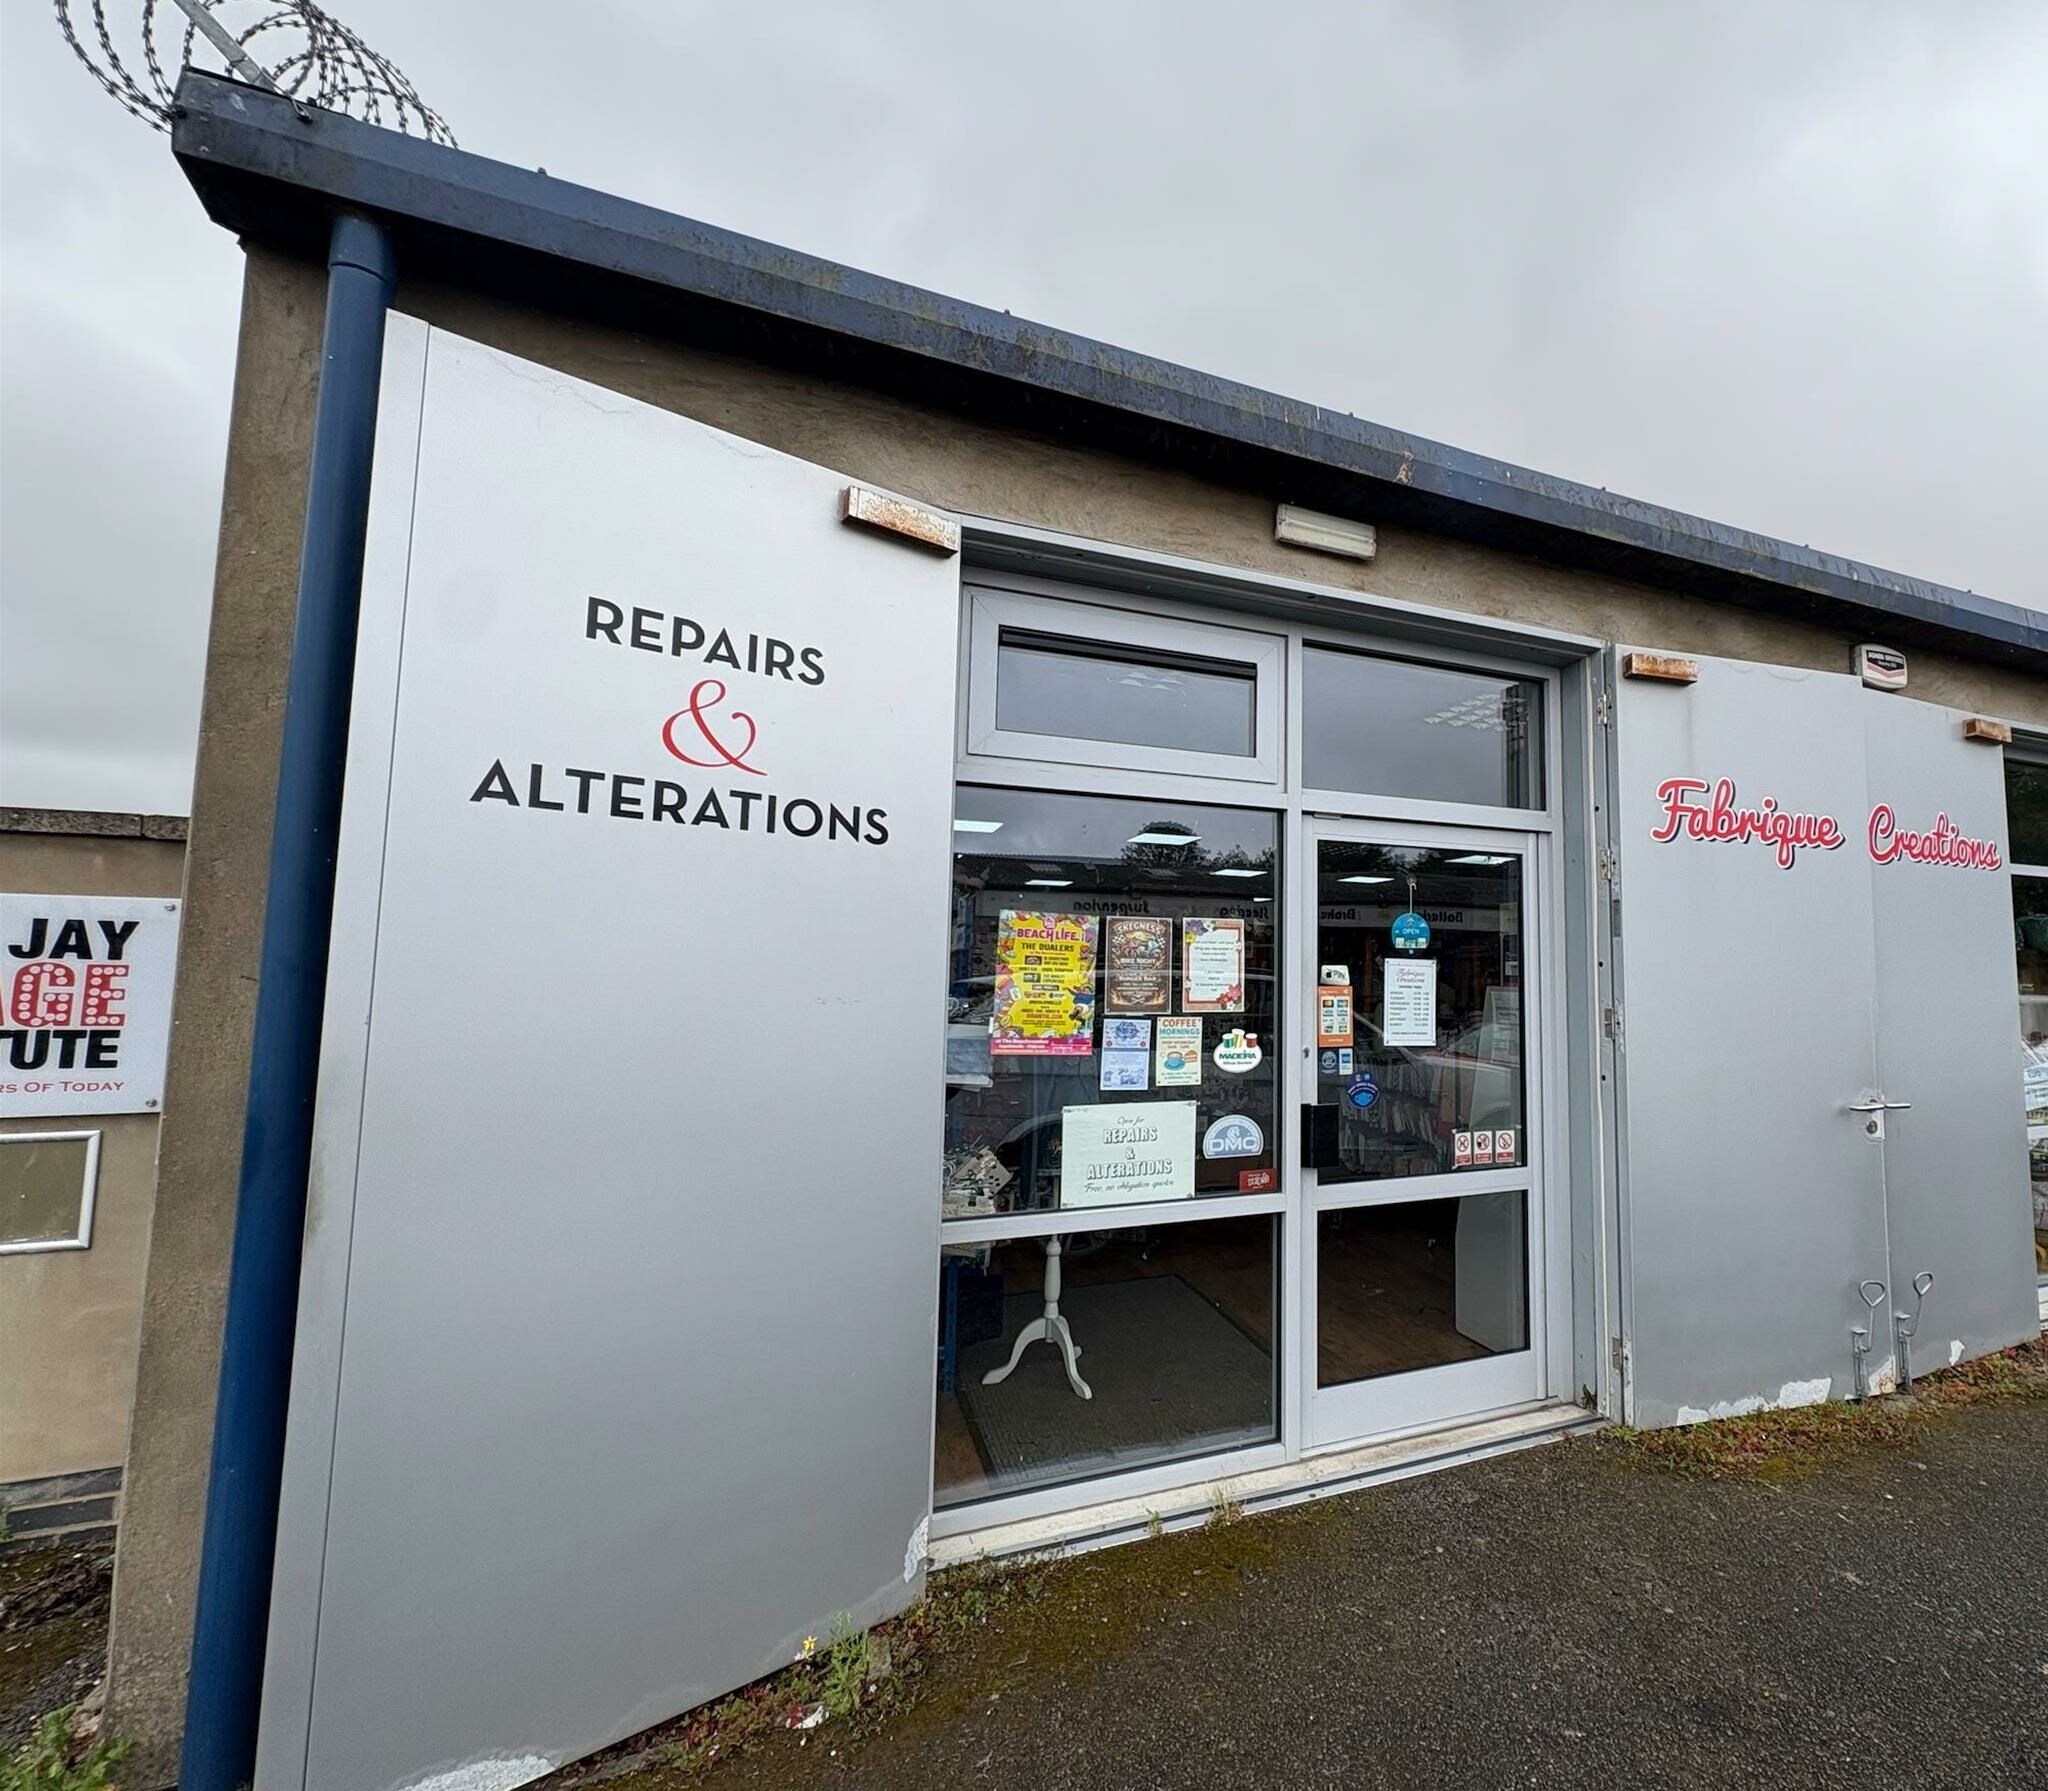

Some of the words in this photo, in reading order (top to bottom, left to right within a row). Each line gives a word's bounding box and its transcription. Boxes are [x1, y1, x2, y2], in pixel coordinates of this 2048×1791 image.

[586, 596, 825, 686] REPAIRS
[662, 679, 768, 776] &
[469, 758, 889, 846] ALTERATIONS
[1651, 777, 1846, 869] Fabrique
[1868, 803, 2002, 870] Creations
[1017, 928, 1054, 942] BEACH
[1056, 927, 1080, 941] LIFE
[1118, 920, 1161, 934] SKEGNESS
[8, 918, 140, 960] JAY
[0, 962, 130, 1027] GE
[1159, 1028, 1201, 1036] MORNINGS
[1162, 1019, 1198, 1028] COFFEE
[1219, 1050, 1256, 1060] MADEIRA
[1103, 1126, 1158, 1144] REPAIRS
[1208, 1136, 1259, 1152] DMC
[1125, 1146, 1136, 1160] &
[1087, 1159, 1173, 1181] ALTERATIONS
